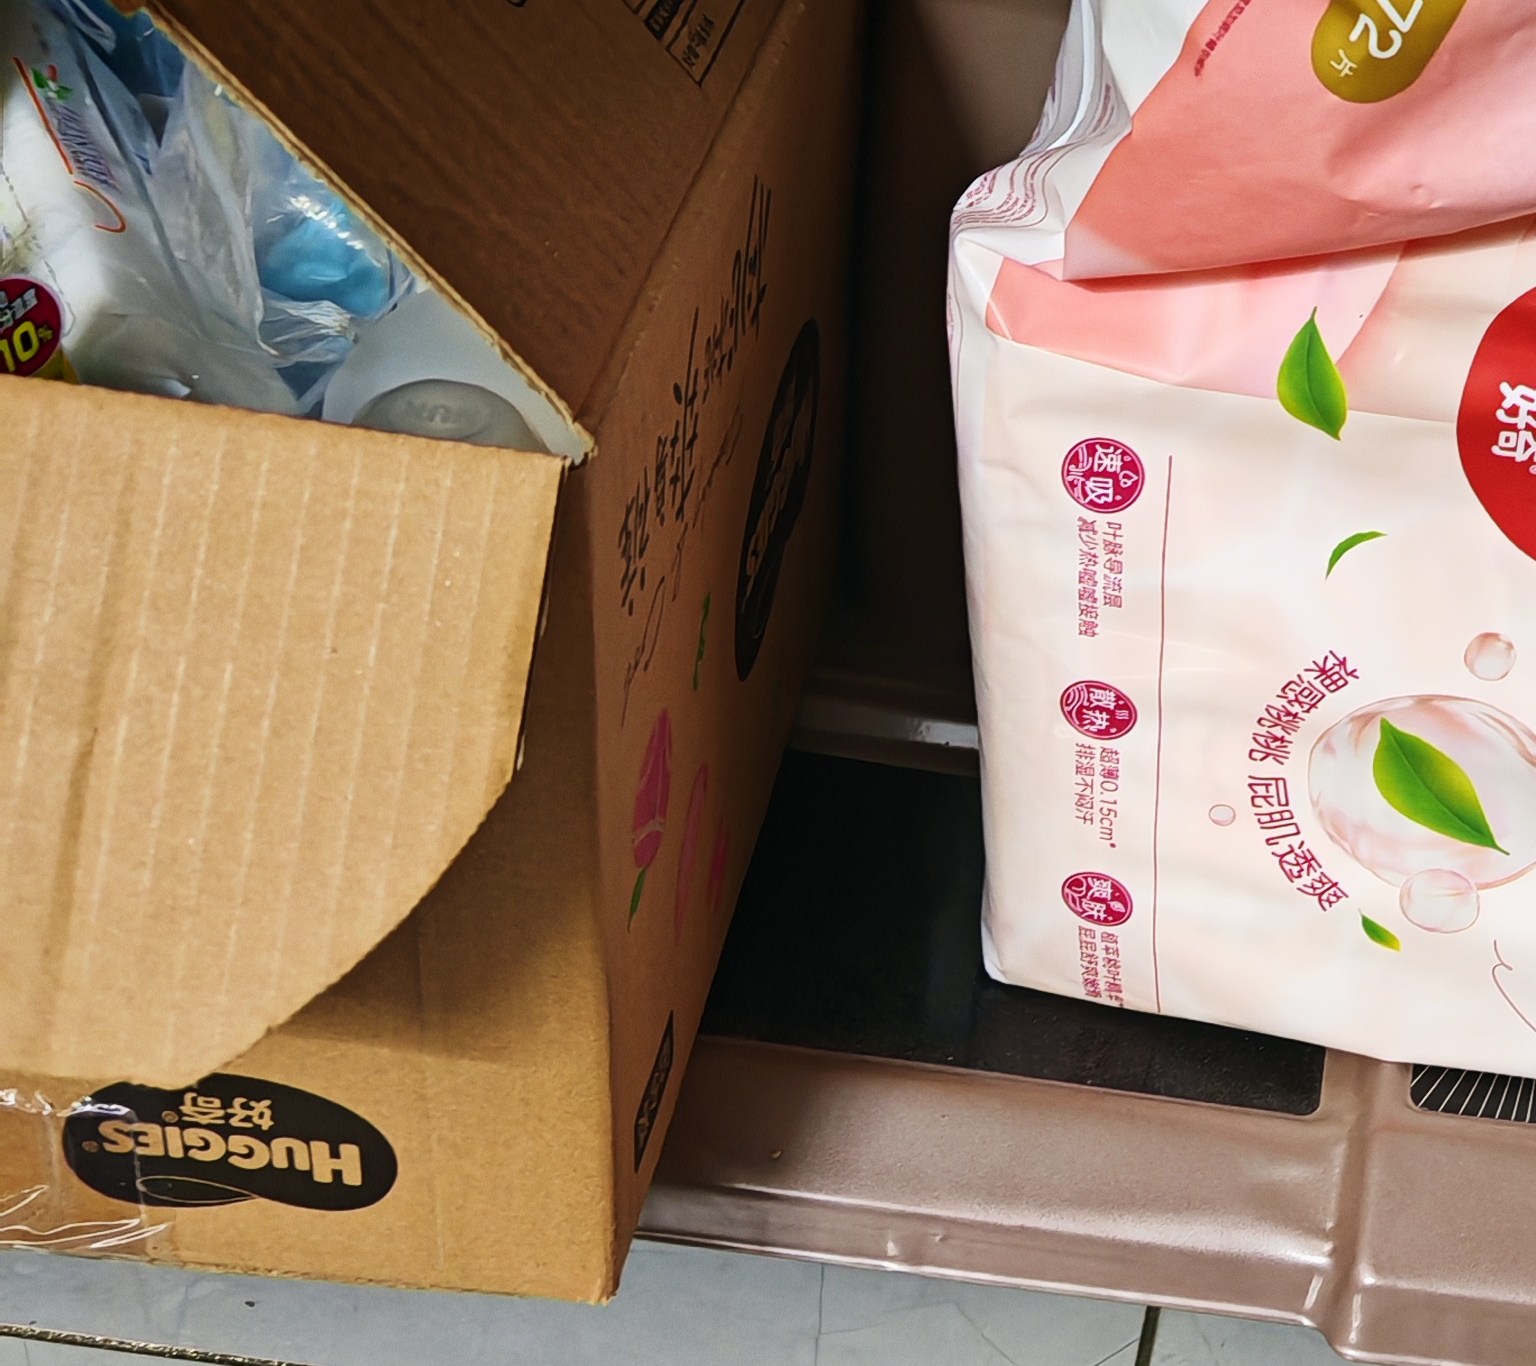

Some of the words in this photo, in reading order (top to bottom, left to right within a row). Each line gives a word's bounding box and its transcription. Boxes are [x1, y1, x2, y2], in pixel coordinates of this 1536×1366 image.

[1084, 443, 1123, 504] 速吸
[1102, 521, 1124, 609] 叶脉导流层
[1081, 686, 1117, 732] 散热
[1247, 650, 1360, 766] 裸感桃桃
[1074, 742, 1097, 826] 排湿不闷汗
[1247, 775, 1350, 912] 屁肌透爽
[1081, 876, 1113, 922] 爽肤
[177, 1091, 275, 1131] 好奇
[97, 1119, 363, 1187] HUGGIES
